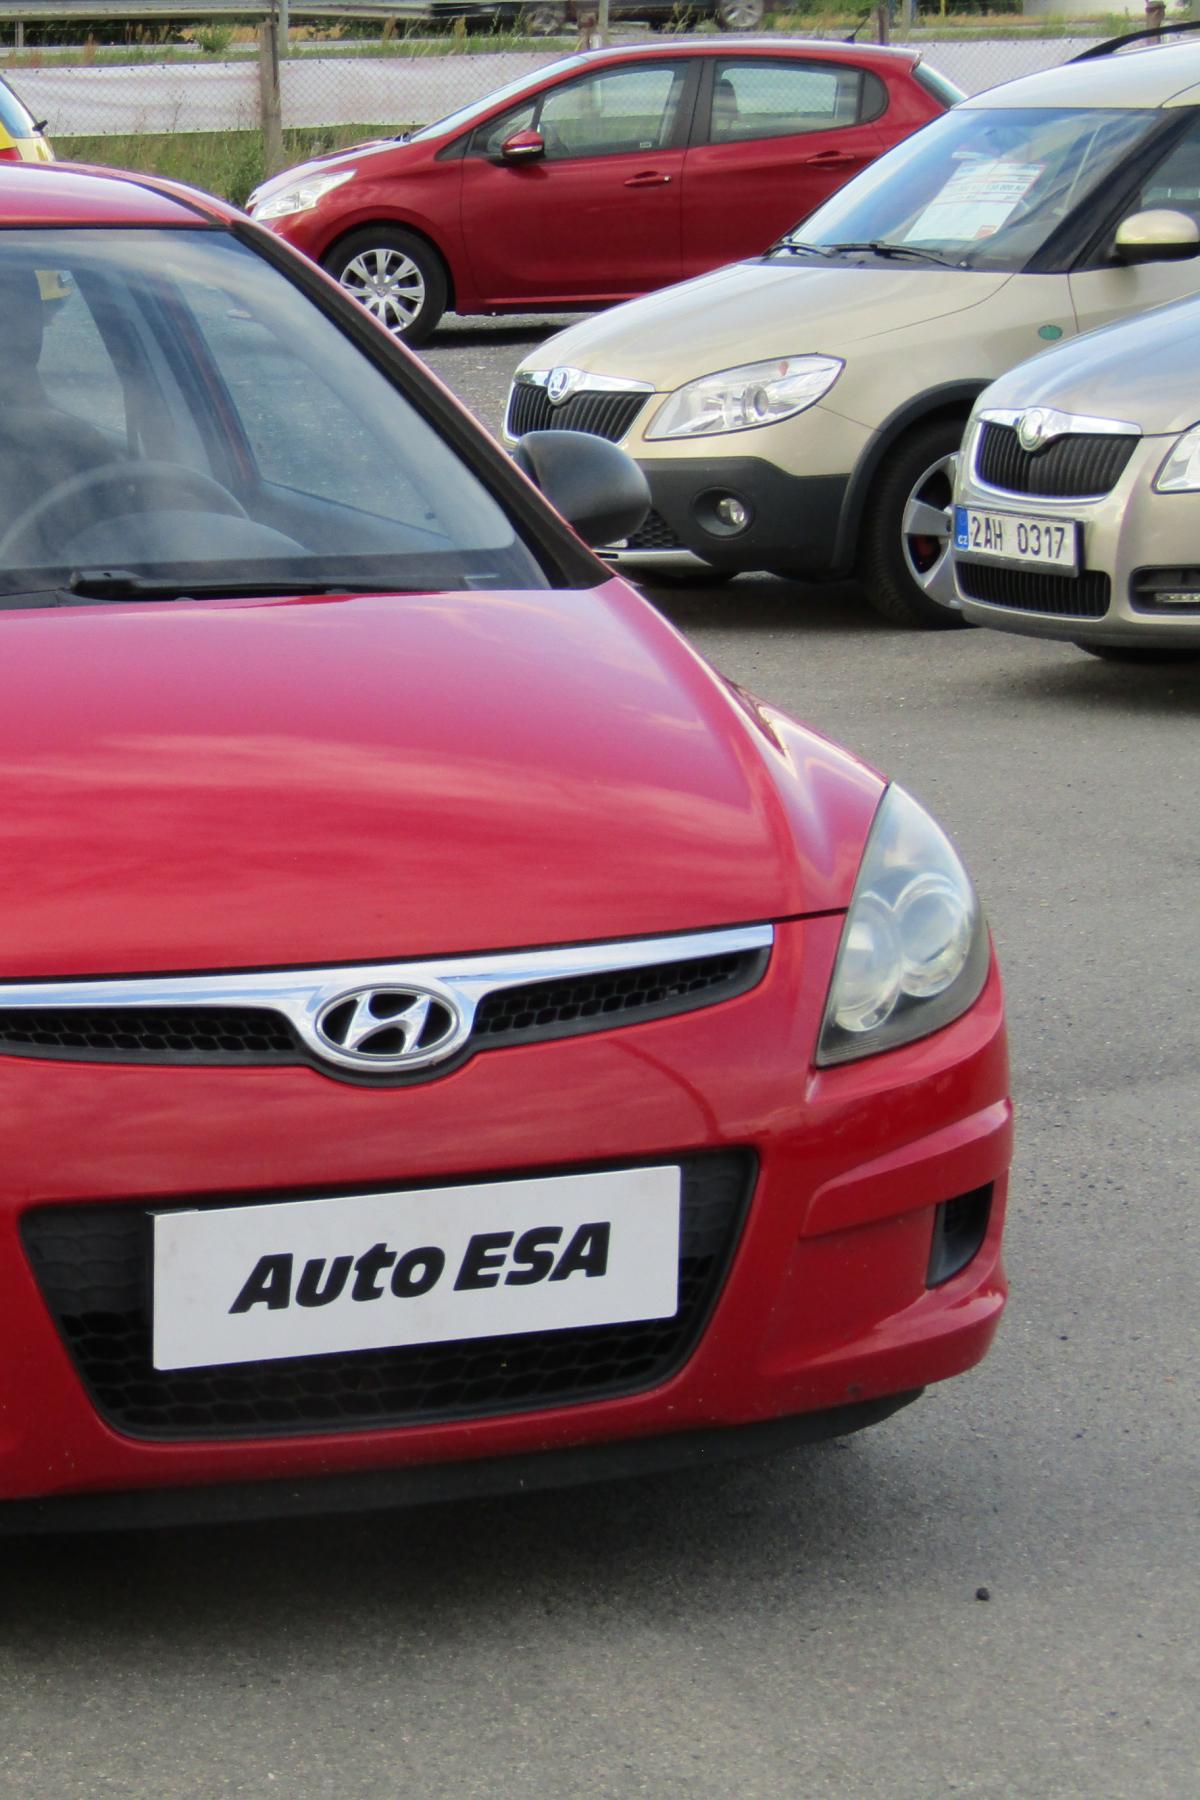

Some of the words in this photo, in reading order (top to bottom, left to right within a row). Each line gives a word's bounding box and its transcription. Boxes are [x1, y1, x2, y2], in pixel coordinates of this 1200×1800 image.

[957, 534, 968, 545] CZ
[971, 515, 1003, 551] 2AH
[1017, 522, 1065, 559] 0317
[228, 1243, 445, 1314] Auto
[454, 1221, 611, 1291] ESA
